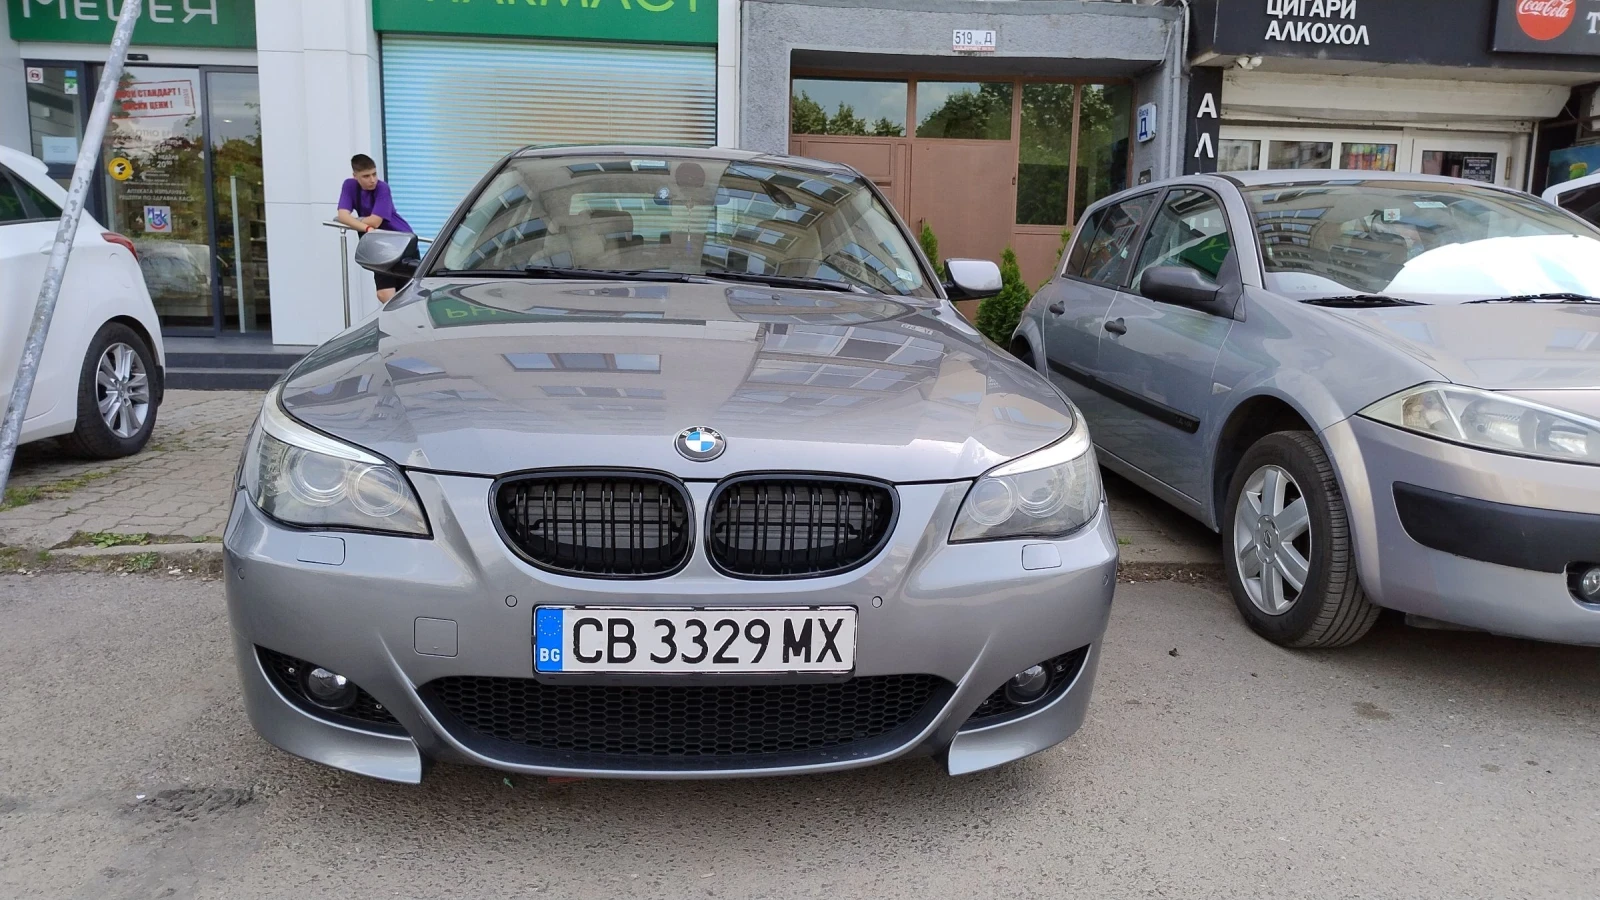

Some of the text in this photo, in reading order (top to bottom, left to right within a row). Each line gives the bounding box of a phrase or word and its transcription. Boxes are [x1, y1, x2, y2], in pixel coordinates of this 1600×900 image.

[1267, 0, 1356, 20] ЦИГАРИ
[954, 31, 973, 45] 519
[984, 32, 992, 45] Д
[1264, 20, 1370, 45] АЛКОХОЛ
[1138, 117, 1148, 140] Д
[572, 617, 845, 664] CB 3329 MX
[539, 648, 560, 662] BG
